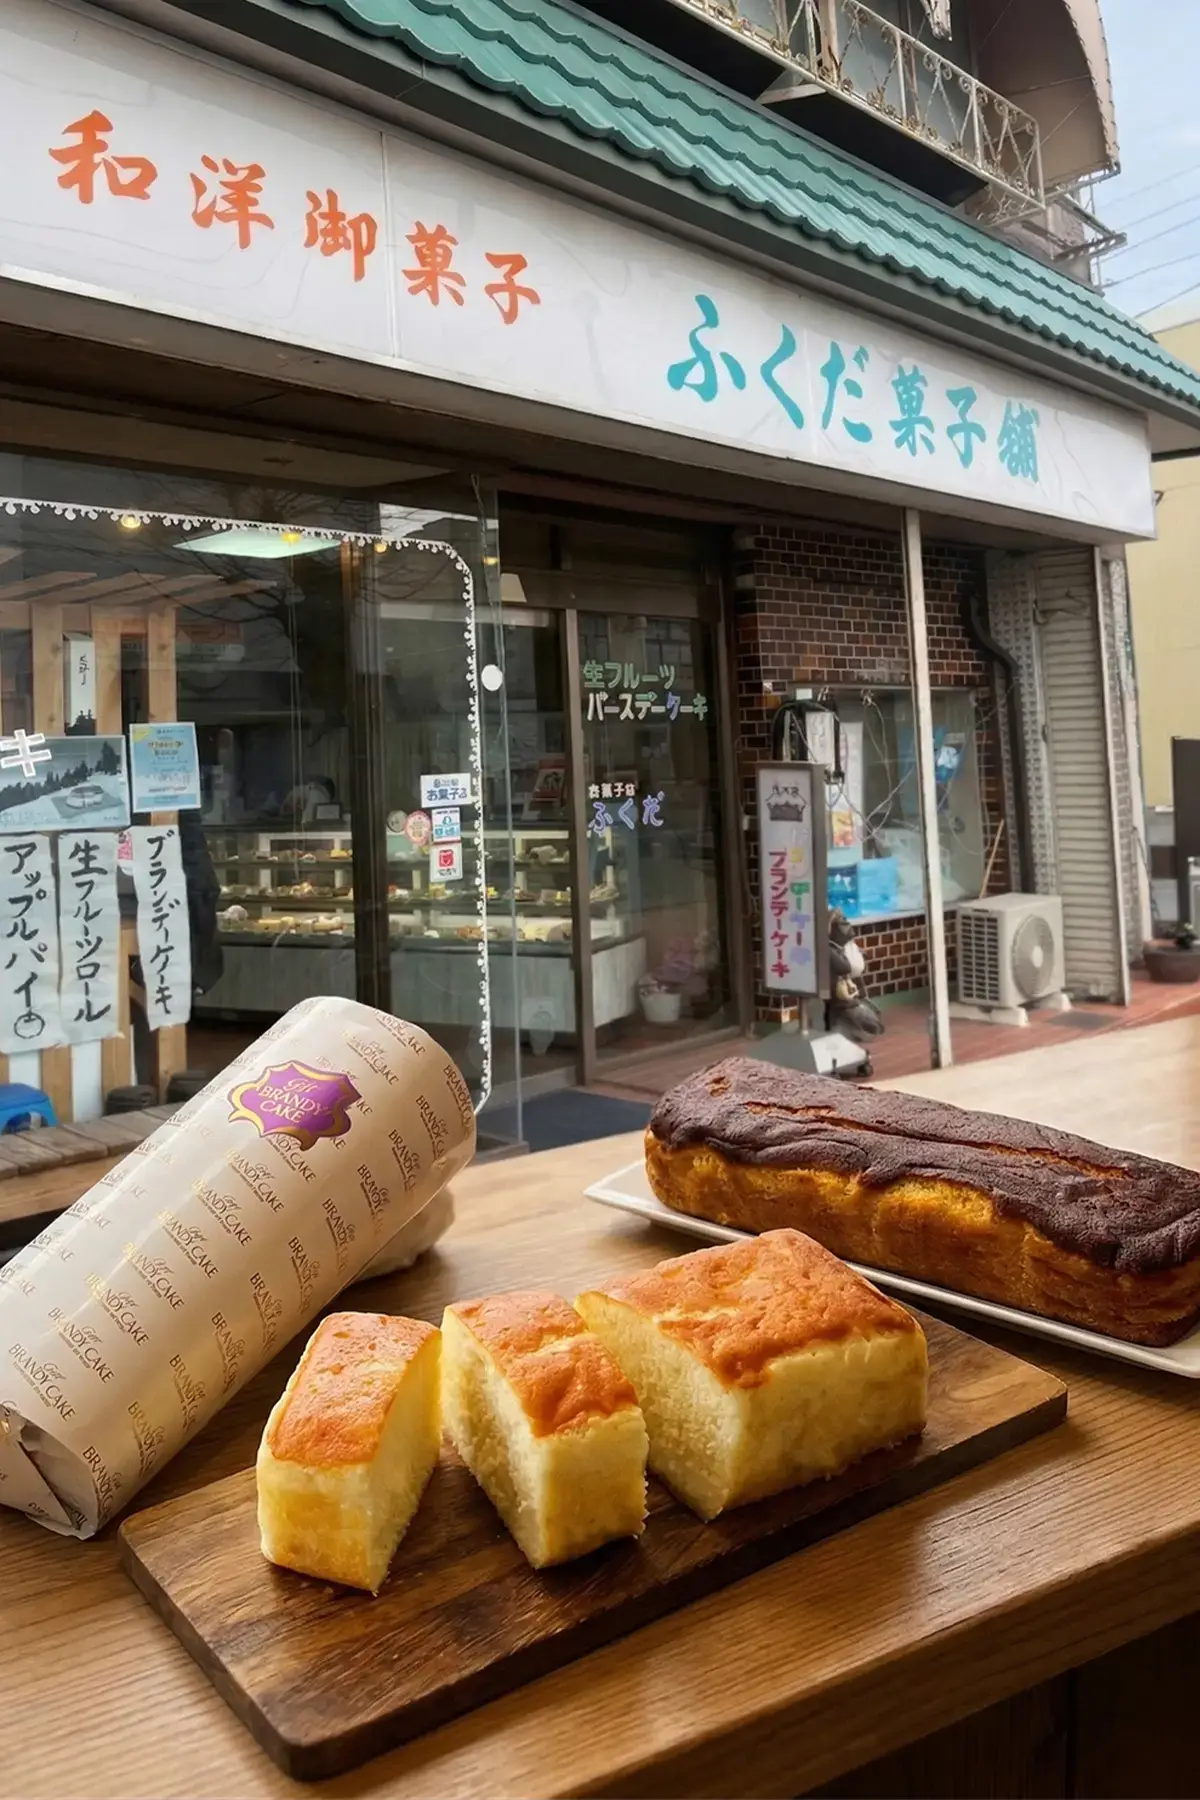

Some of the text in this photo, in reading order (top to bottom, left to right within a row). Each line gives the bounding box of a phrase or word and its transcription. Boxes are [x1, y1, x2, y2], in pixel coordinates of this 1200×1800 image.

[49, 109, 541, 325] 和洋御菓子
[667, 294, 1039, 483] ふくだ菓子舗
[583, 660, 675, 689] 生フルーツ
[587, 692, 708, 721] バースデーケーキ
[588, 791, 665, 838] ふくだ
[4, 842, 48, 1008] アップルパイ
[68, 839, 112, 1022] 生フルーツロール
[147, 829, 181, 1015] ブランデーケーキ
[258, 1085, 328, 1116] BRANDY
[260, 1100, 305, 1123] CAKE
[290, 1152, 317, 1183] CAKE
[258, 1182, 285, 1213] CAKE
[225, 1214, 252, 1246] CAKE
[191, 1245, 219, 1279] CAKE
[87, 1273, 127, 1312] BRNDY
[121, 1312, 149, 1346] CAKE
[156, 1277, 184, 1310] CAKE
[8, 1343, 52, 1385] BRANDY
[46, 1385, 76, 1421] CAKE
[84, 1347, 115, 1383] CAKE
